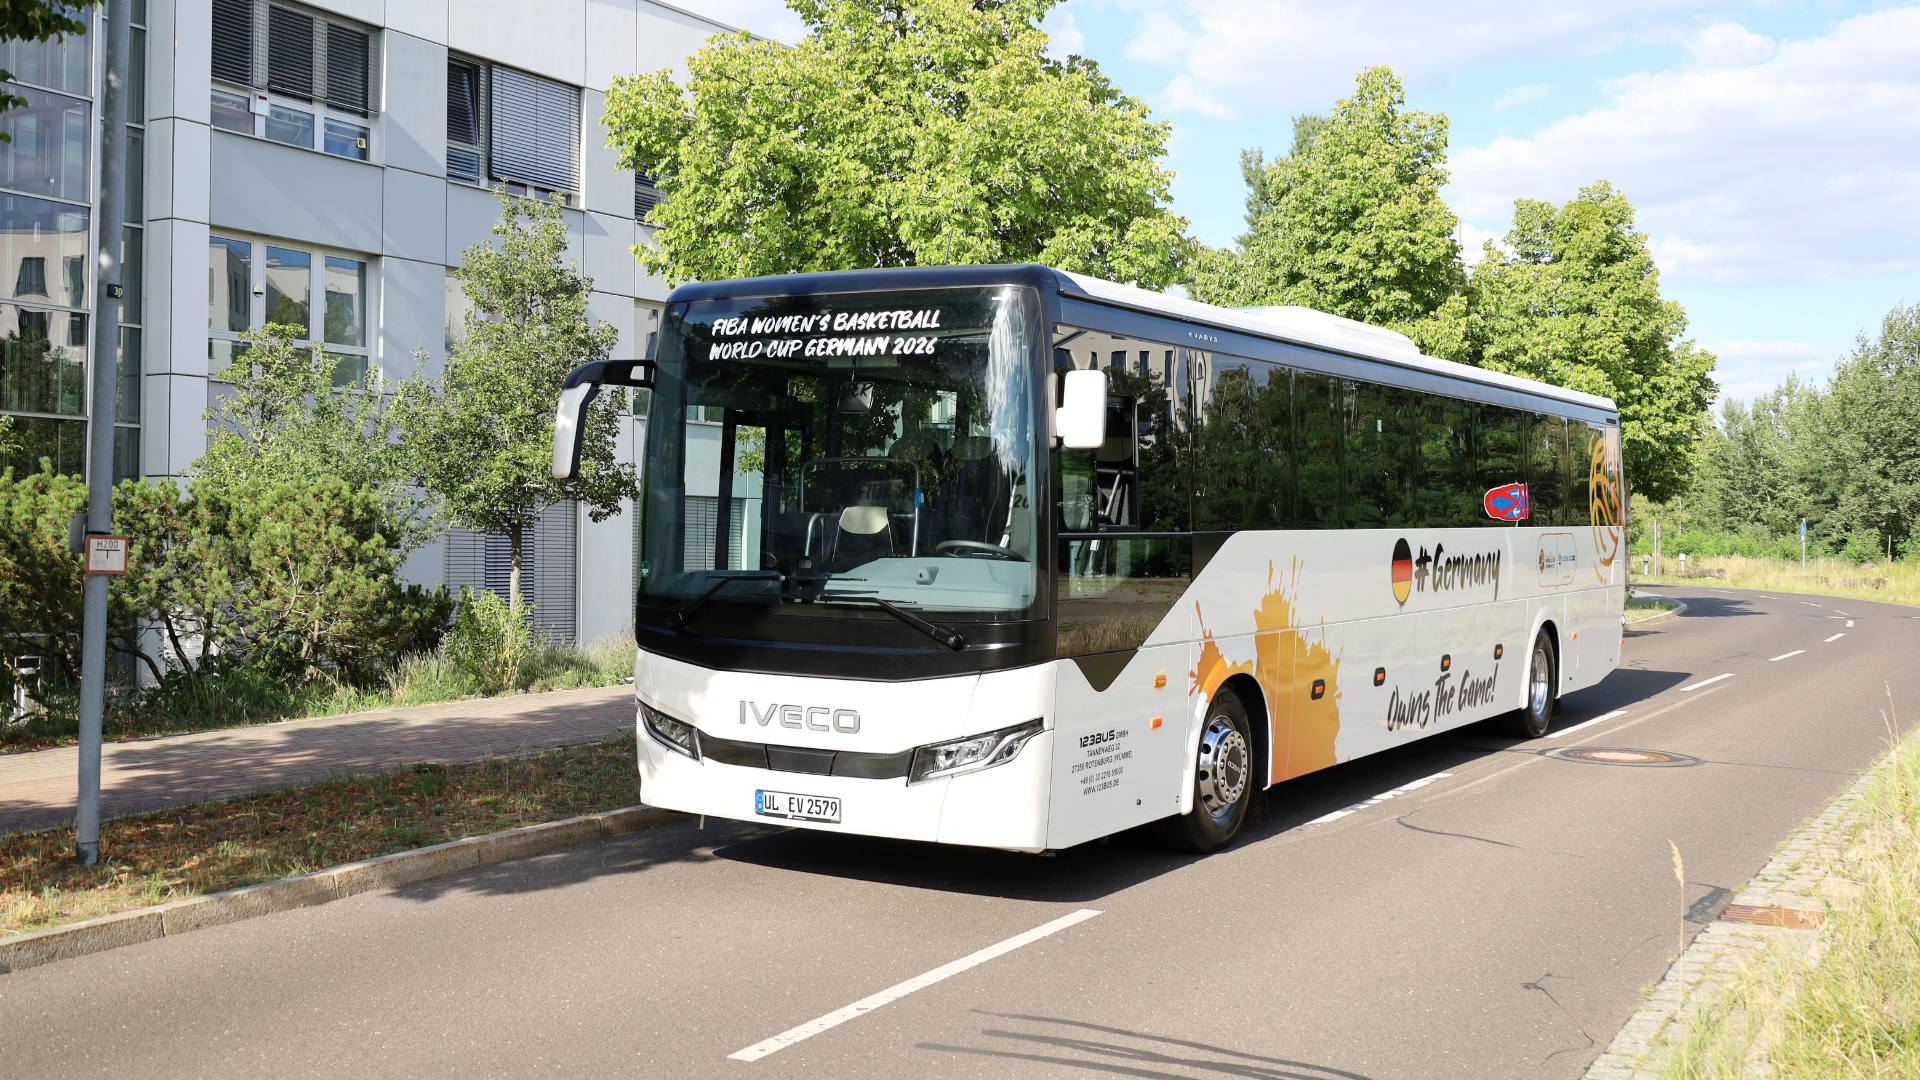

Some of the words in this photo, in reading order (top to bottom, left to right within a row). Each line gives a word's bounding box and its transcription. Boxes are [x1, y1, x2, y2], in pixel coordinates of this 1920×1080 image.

[711, 317, 747, 337] FIBA
[750, 312, 830, 335] WOMEN'S
[833, 309, 941, 332] BASKETBALL
[1188, 331, 1218, 343] EVADYS
[709, 340, 763, 361] WORLD
[766, 340, 802, 359] CUP
[804, 336, 890, 357] GERMANY
[892, 336, 938, 356] 2026
[96, 540, 119, 549] H200
[1414, 542, 1501, 601] #Germany
[1387, 685, 1431, 732] Owns
[1433, 672, 1456, 724] The
[1458, 662, 1499, 712] Game!
[739, 700, 861, 734] IVECO
[1079, 729, 1115, 748] 123BUS
[1087, 744, 1115, 757] TANNENWEG
[1085, 755, 1113, 769] ROTENBURG
[1083, 778, 1120, 796] WWW.123BUS.DE
[764, 794, 779, 811] UL
[788, 796, 804, 813] EV
[807, 798, 838, 817] 2579
